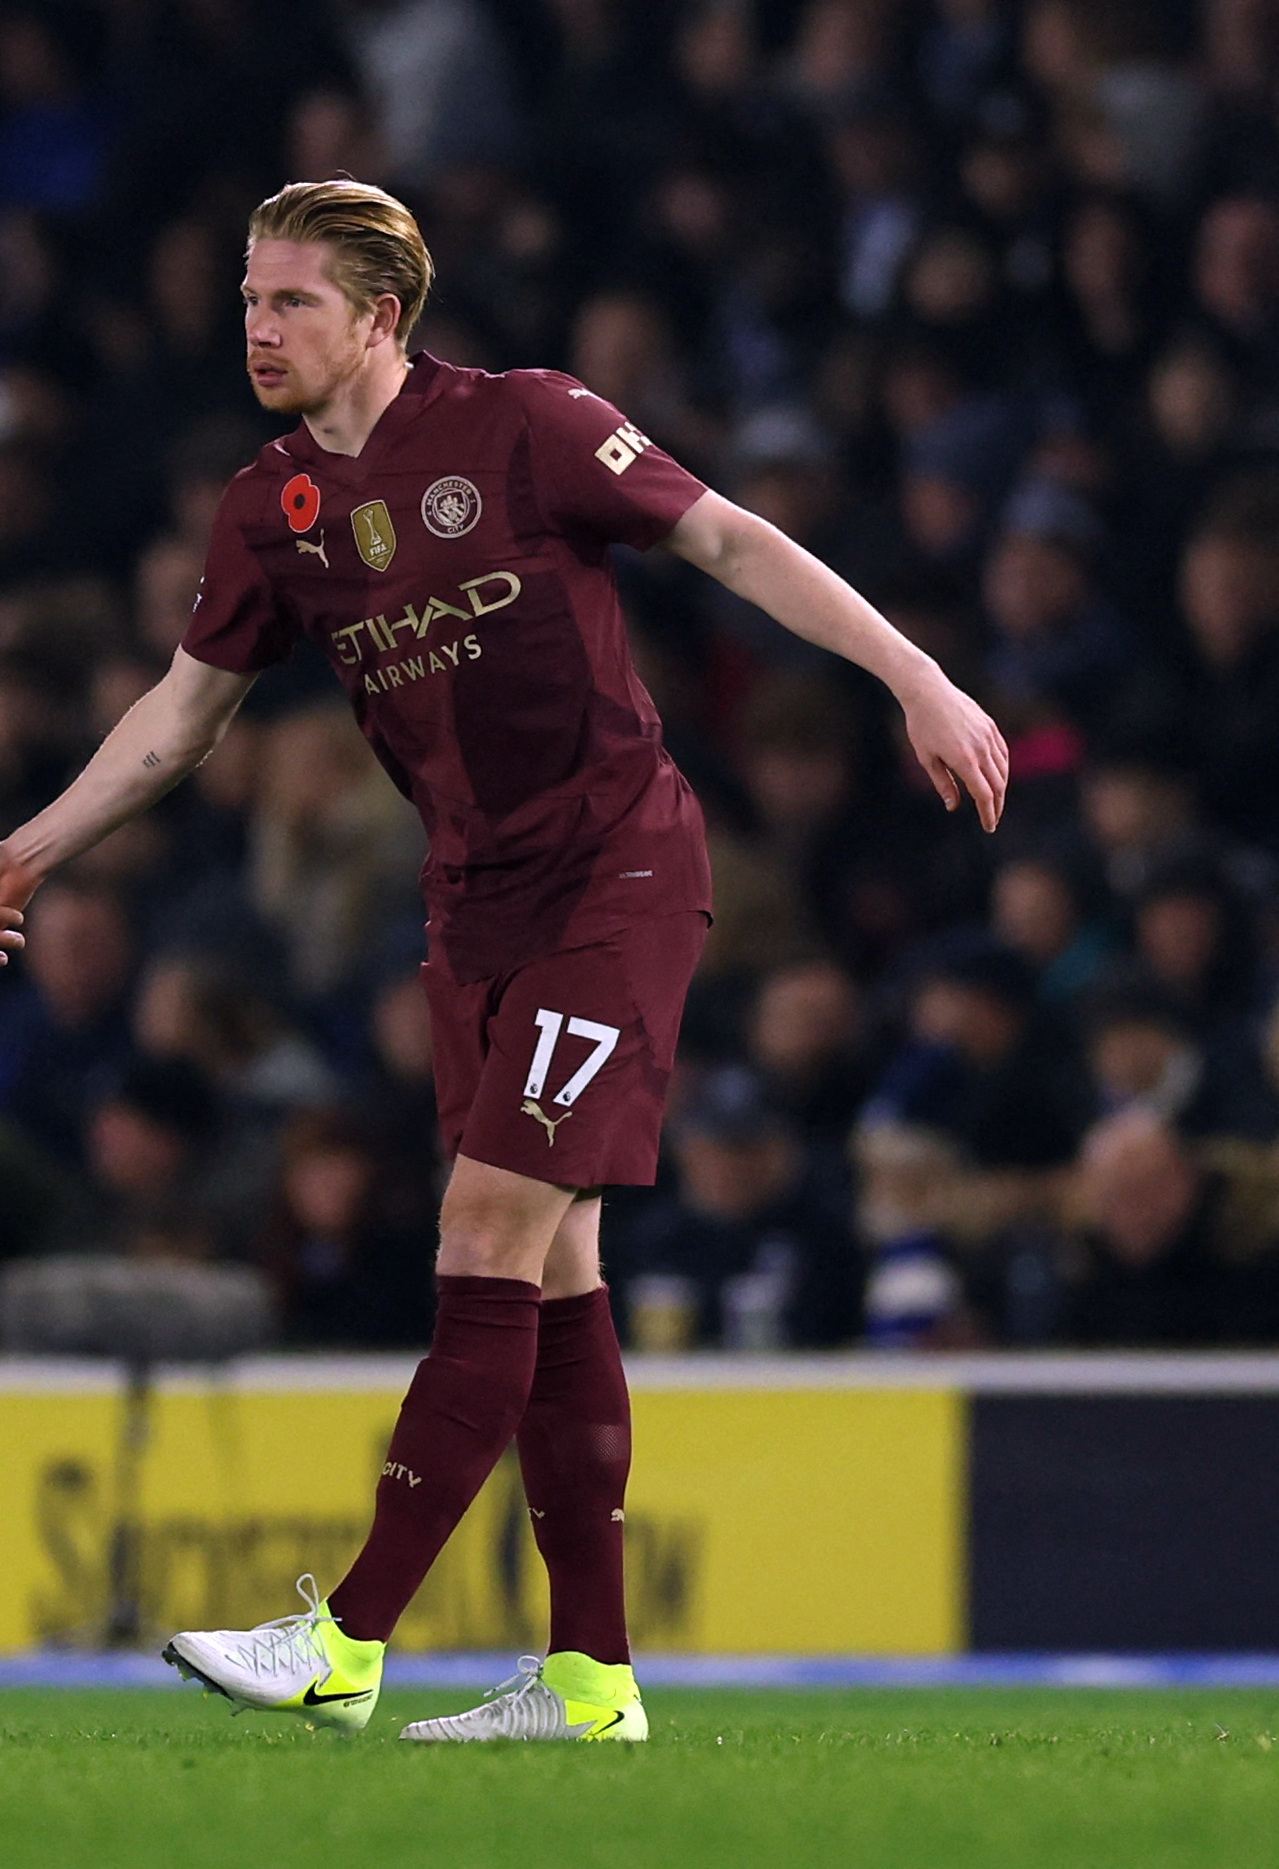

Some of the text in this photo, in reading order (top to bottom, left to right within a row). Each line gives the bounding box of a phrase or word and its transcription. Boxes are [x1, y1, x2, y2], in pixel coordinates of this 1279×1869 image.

[426, 480, 472, 506] MANCHESTER
[447, 523, 465, 535] CITY
[369, 543, 388, 557] FIFA
[331, 570, 522, 665] ETIHAD
[364, 634, 482, 696] AIRWAYS
[523, 1008, 620, 1107] 17
[382, 1461, 422, 1488] CITY
